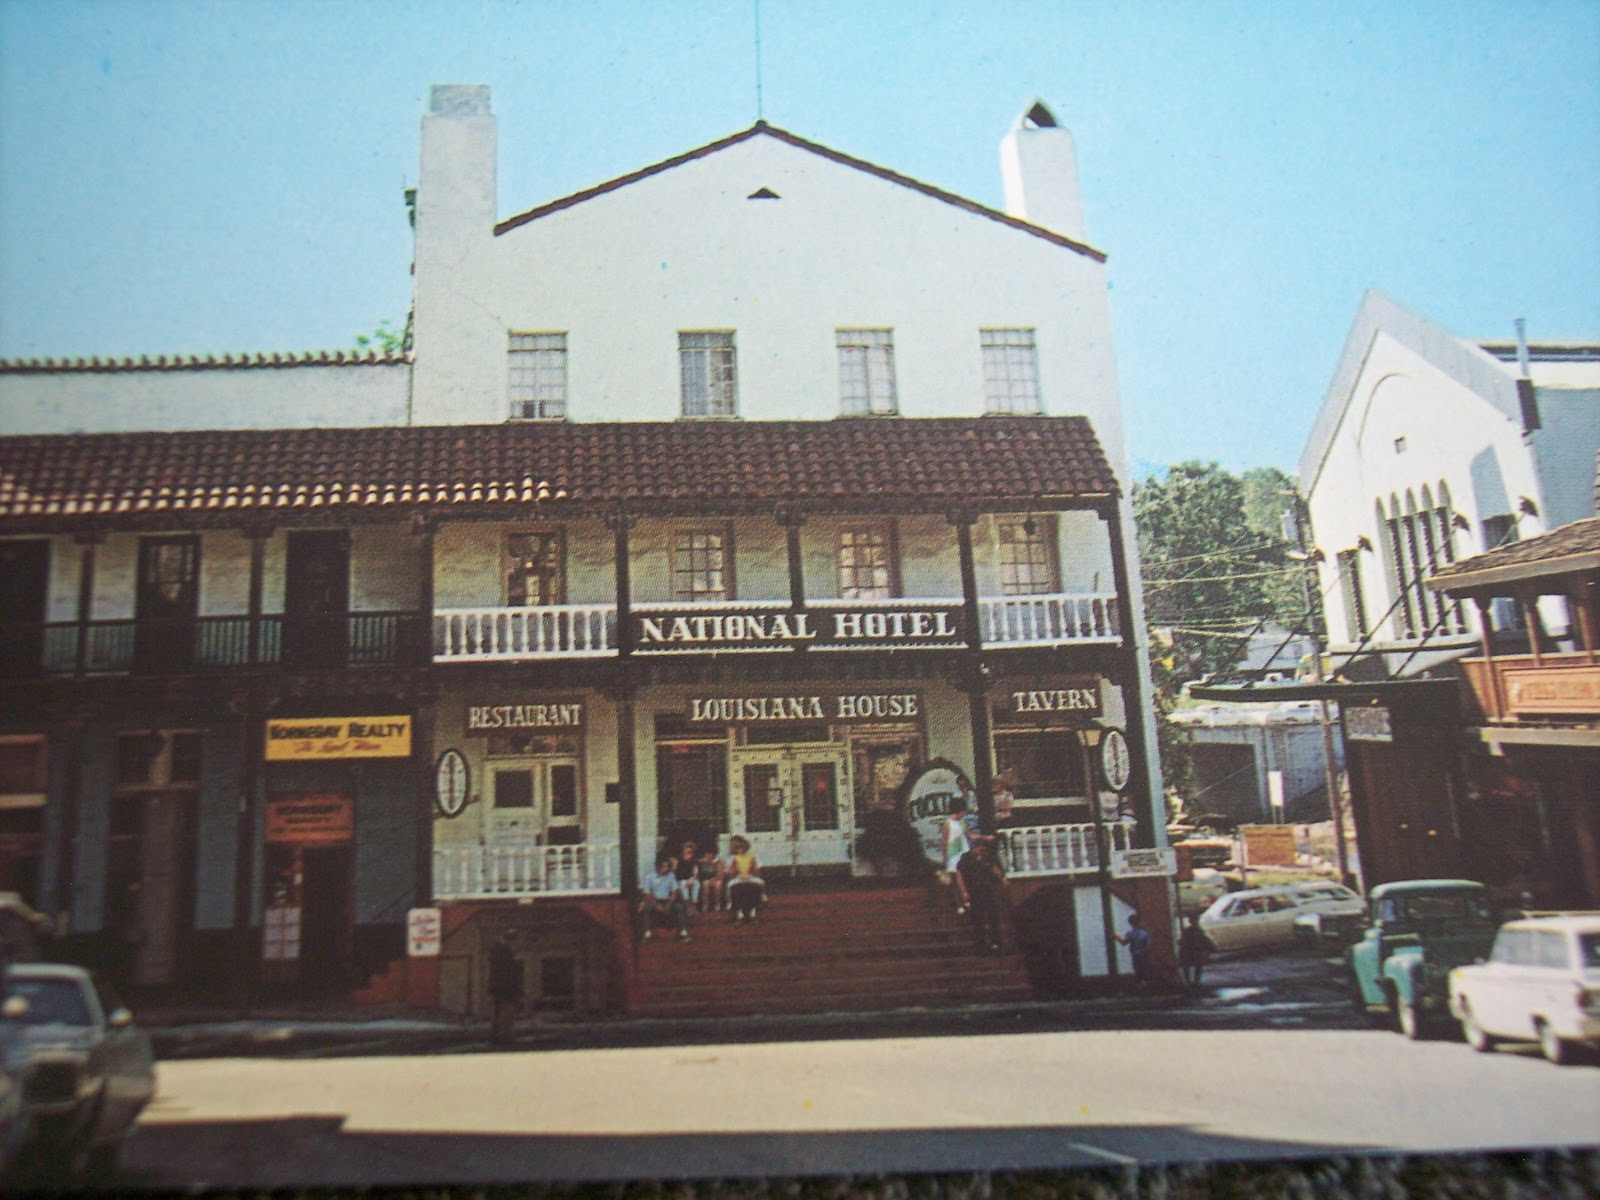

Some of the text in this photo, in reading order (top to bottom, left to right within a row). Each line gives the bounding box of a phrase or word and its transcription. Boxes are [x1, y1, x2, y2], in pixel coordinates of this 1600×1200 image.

[639, 612, 957, 643] NATIONAL HOTEL
[691, 694, 919, 721] LOUISIANA HOUSE
[1013, 688, 1098, 712] TAVERN
[468, 703, 582, 729] RESTAURANT
[349, 722, 406, 739] REALTY
